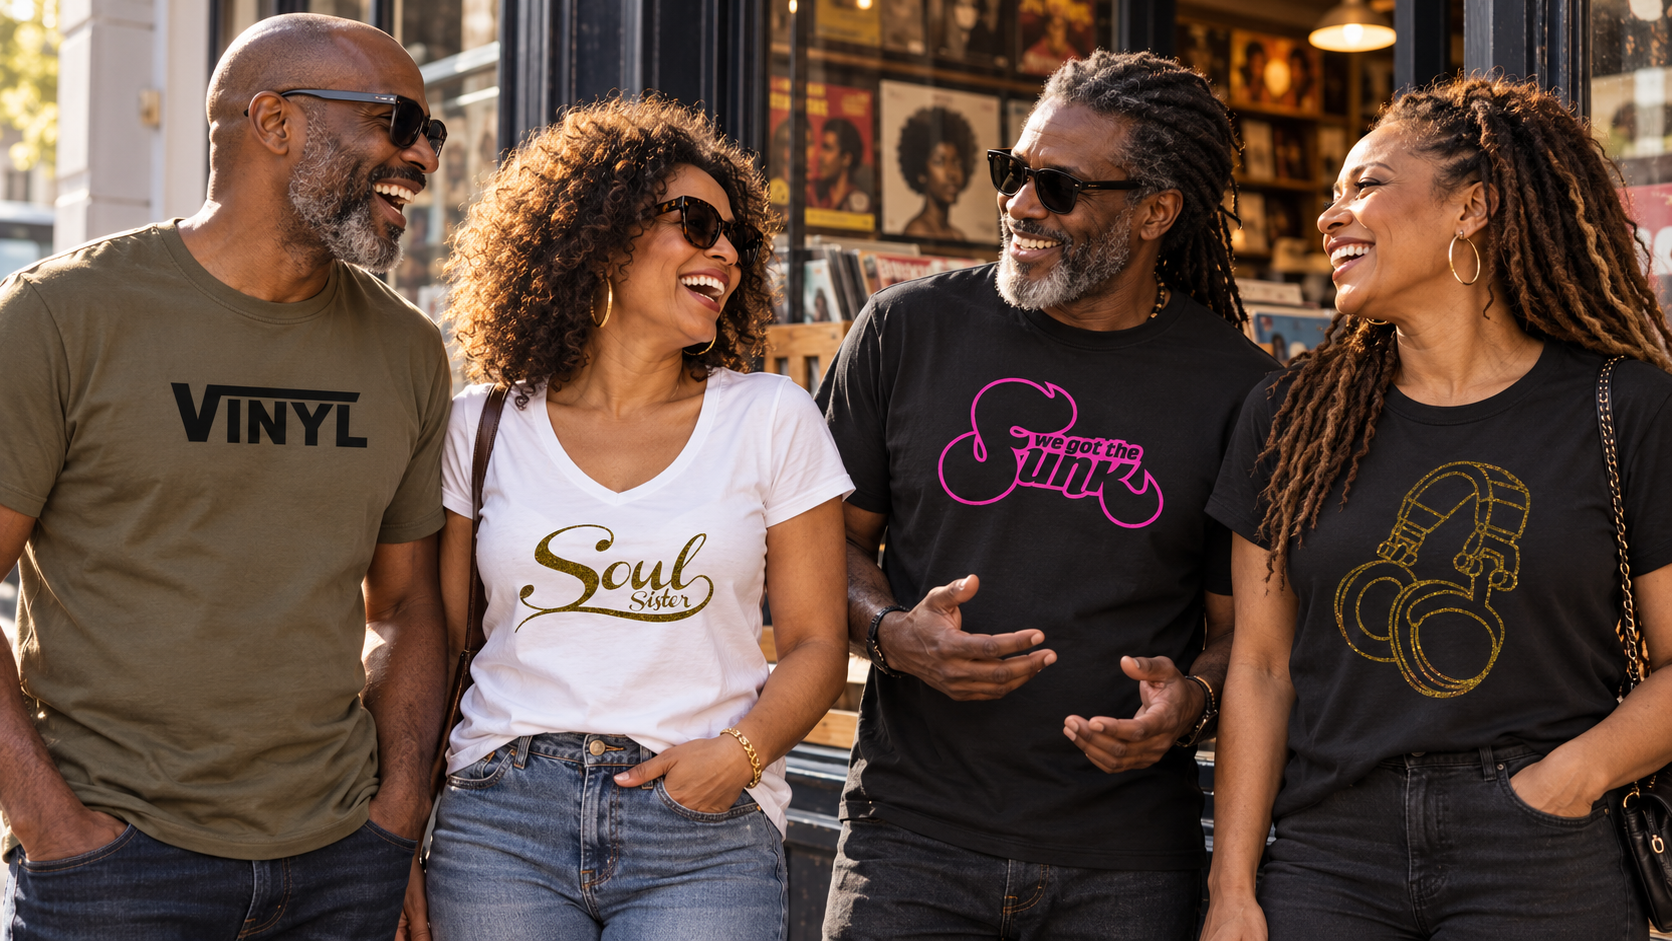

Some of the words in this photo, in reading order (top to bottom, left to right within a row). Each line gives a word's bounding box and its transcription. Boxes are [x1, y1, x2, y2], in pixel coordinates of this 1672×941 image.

[171, 382, 368, 448] VINYL
[1035, 435, 1063, 449] we
[1065, 439, 1102, 455] got
[1106, 443, 1139, 460] the
[515, 524, 714, 633] Soul
[629, 588, 691, 612] Sister
